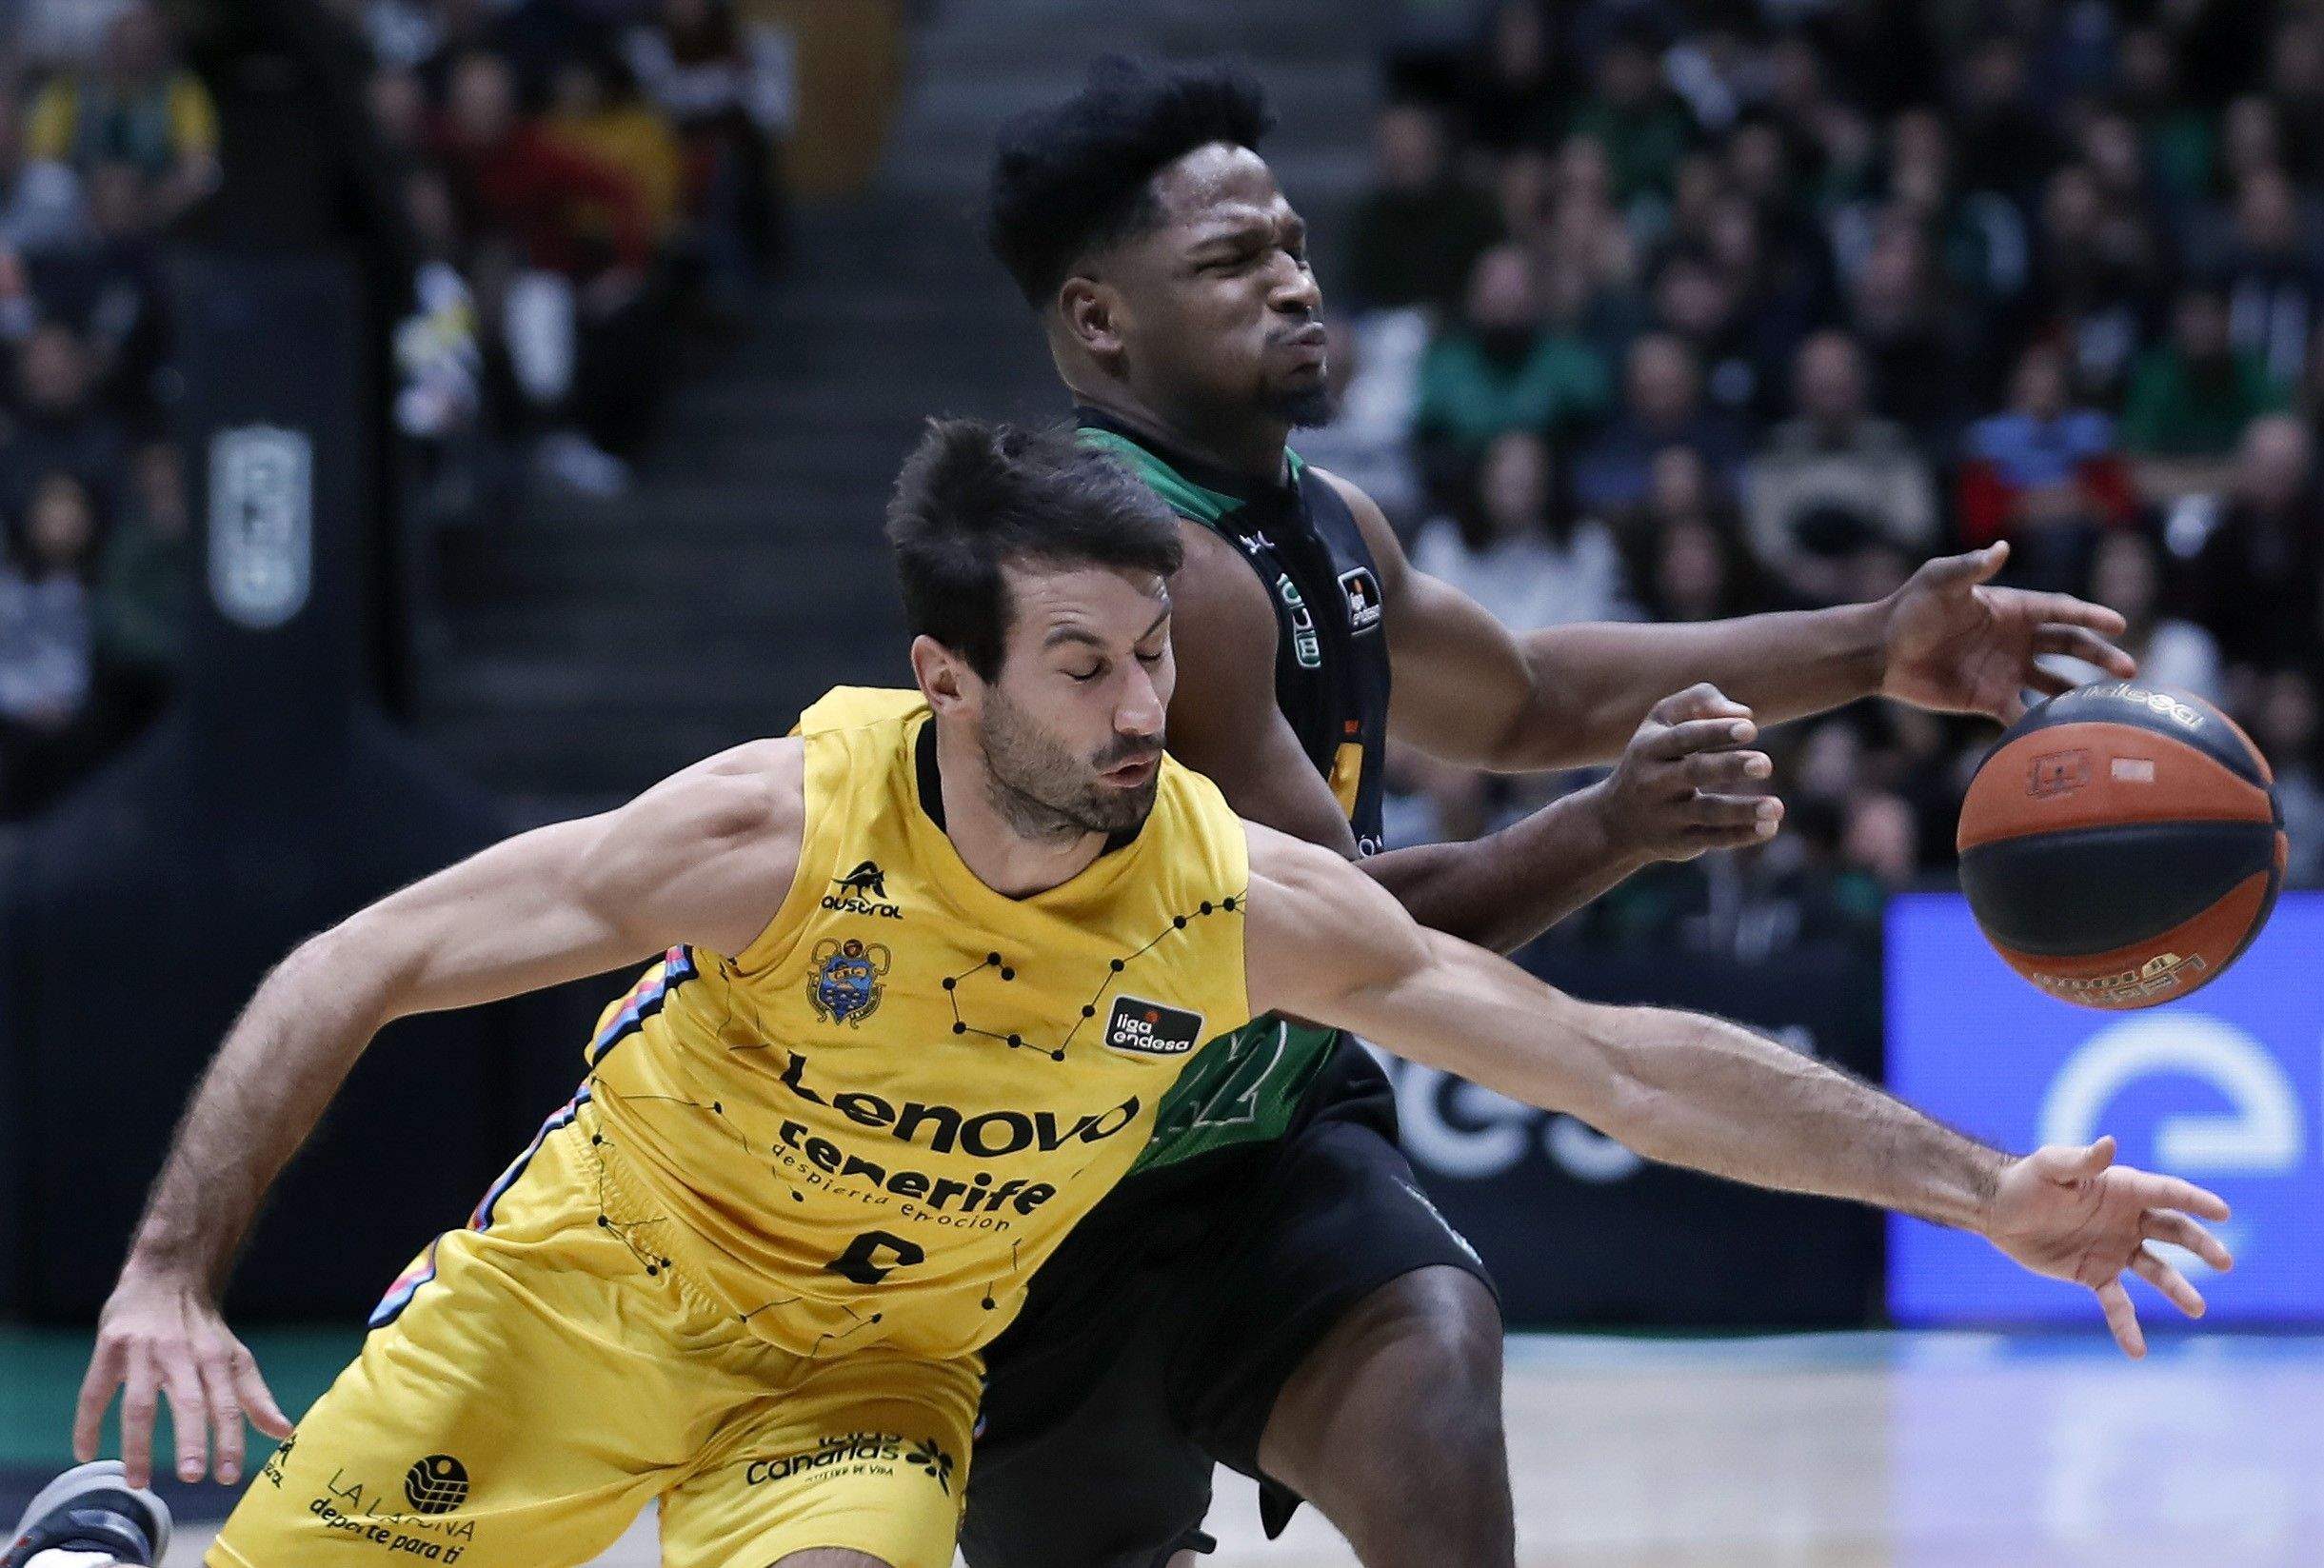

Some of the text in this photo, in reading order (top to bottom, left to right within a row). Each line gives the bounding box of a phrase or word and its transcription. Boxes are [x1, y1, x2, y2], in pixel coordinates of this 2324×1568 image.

[822, 895, 904, 920] austral
[1113, 1031, 1190, 1051] endesa
[1116, 1013, 1152, 1035] liga
[779, 1048, 1141, 1159] Lenovo
[772, 1142, 890, 1205] despierta
[778, 1119, 1057, 1217] tenerife
[326, 1468, 364, 1510] LA
[388, 1534, 442, 1559] para
[442, 1545, 466, 1565] ti
